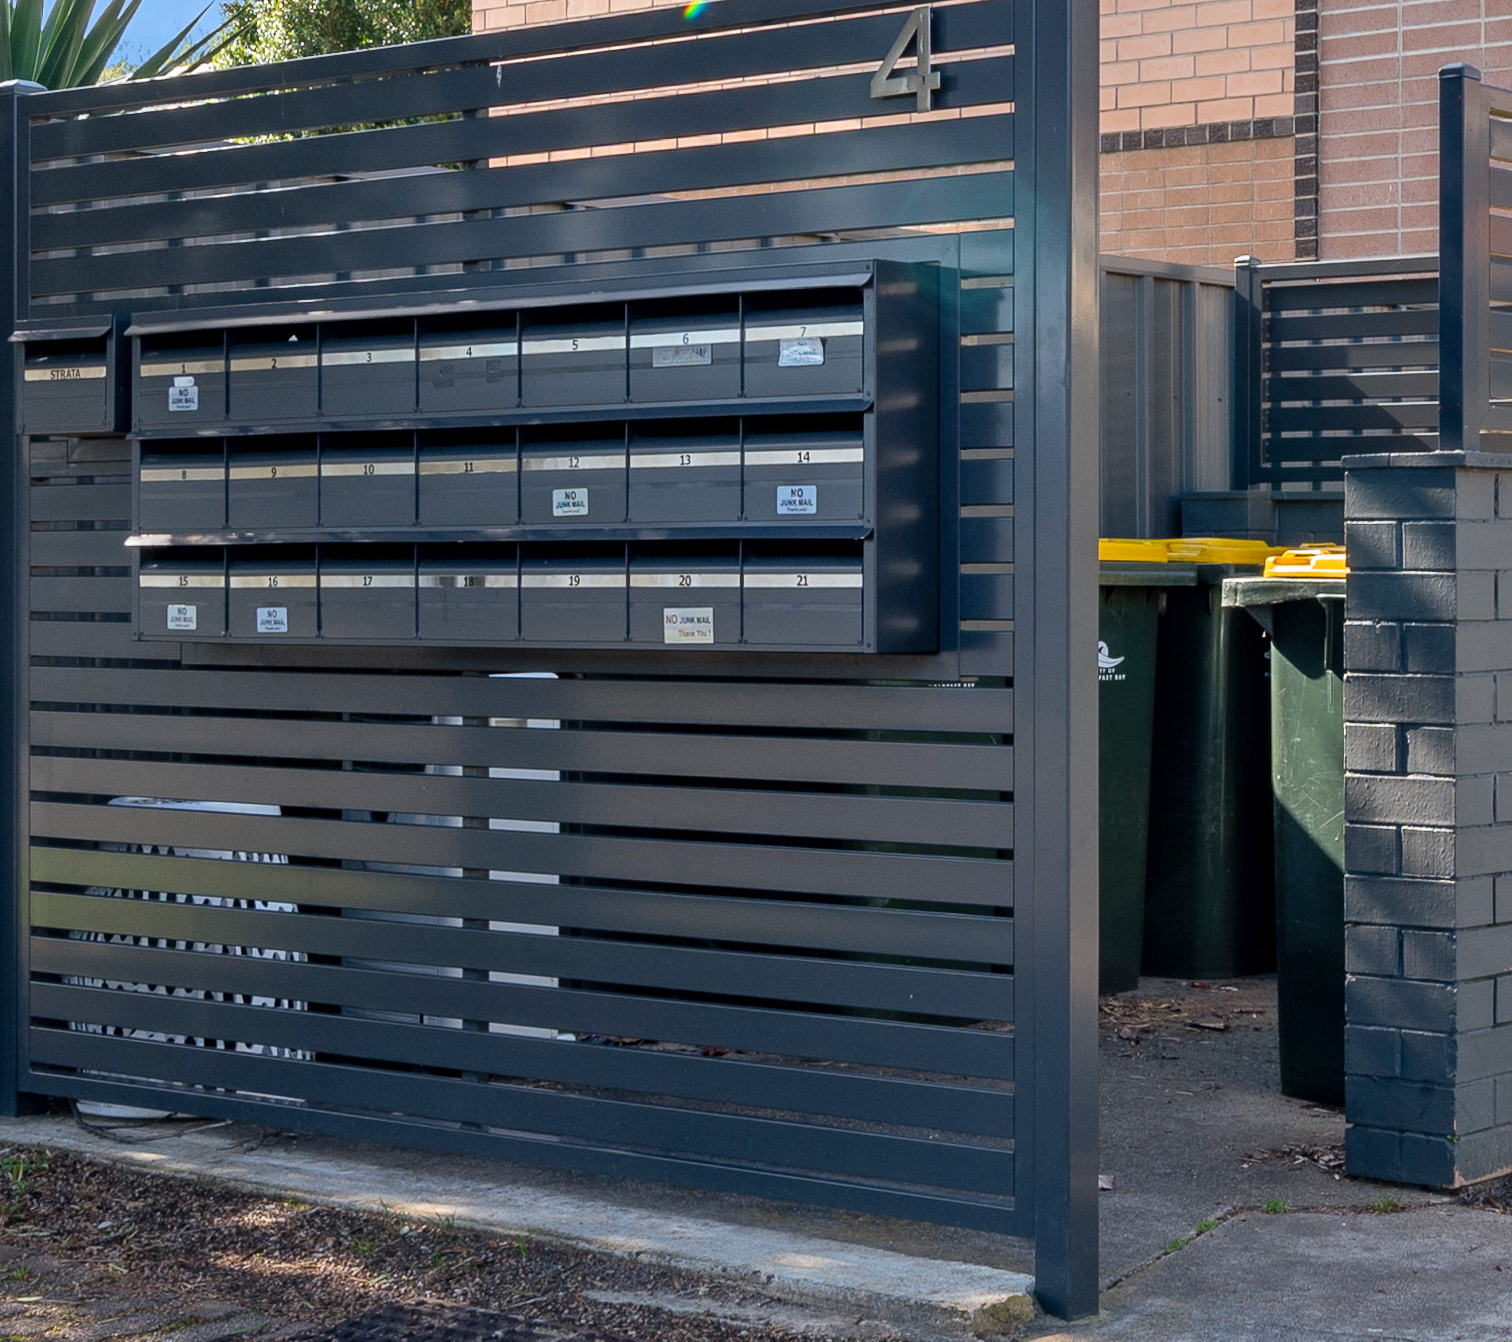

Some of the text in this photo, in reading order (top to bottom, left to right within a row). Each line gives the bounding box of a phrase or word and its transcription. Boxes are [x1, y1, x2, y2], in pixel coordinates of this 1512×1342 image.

[870, 4, 941, 114] 4
[800, 326, 807, 337] 7
[683, 332, 689, 346] 6
[572, 339, 578, 351] 5
[366, 352, 372, 363] 3
[466, 347, 473, 357] 4
[182, 363, 186, 374] 1
[272, 359, 277, 369] 2
[50, 369, 82, 380] STRATA
[569, 456, 580, 468] 12
[680, 455, 691, 466] 13
[798, 451, 810, 463] 14
[271, 467, 277, 478] 9
[363, 464, 374, 476] 10
[464, 461, 474, 473] 11
[181, 470, 187, 480] 8
[565, 491, 577, 500] NO
[790, 488, 804, 498] NO
[556, 501, 571, 509] JUNK
[781, 499, 813, 507] JUNK MAIL
[179, 576, 188, 587] 15
[268, 576, 278, 588] 16
[363, 576, 373, 587] 17
[463, 576, 474, 587] 18
[569, 575, 580, 586] 19
[679, 575, 692, 586] 20
[796, 575, 808, 586] 21
[267, 610, 278, 618] NO
[666, 614, 711, 625] NO JUNK MAIL
